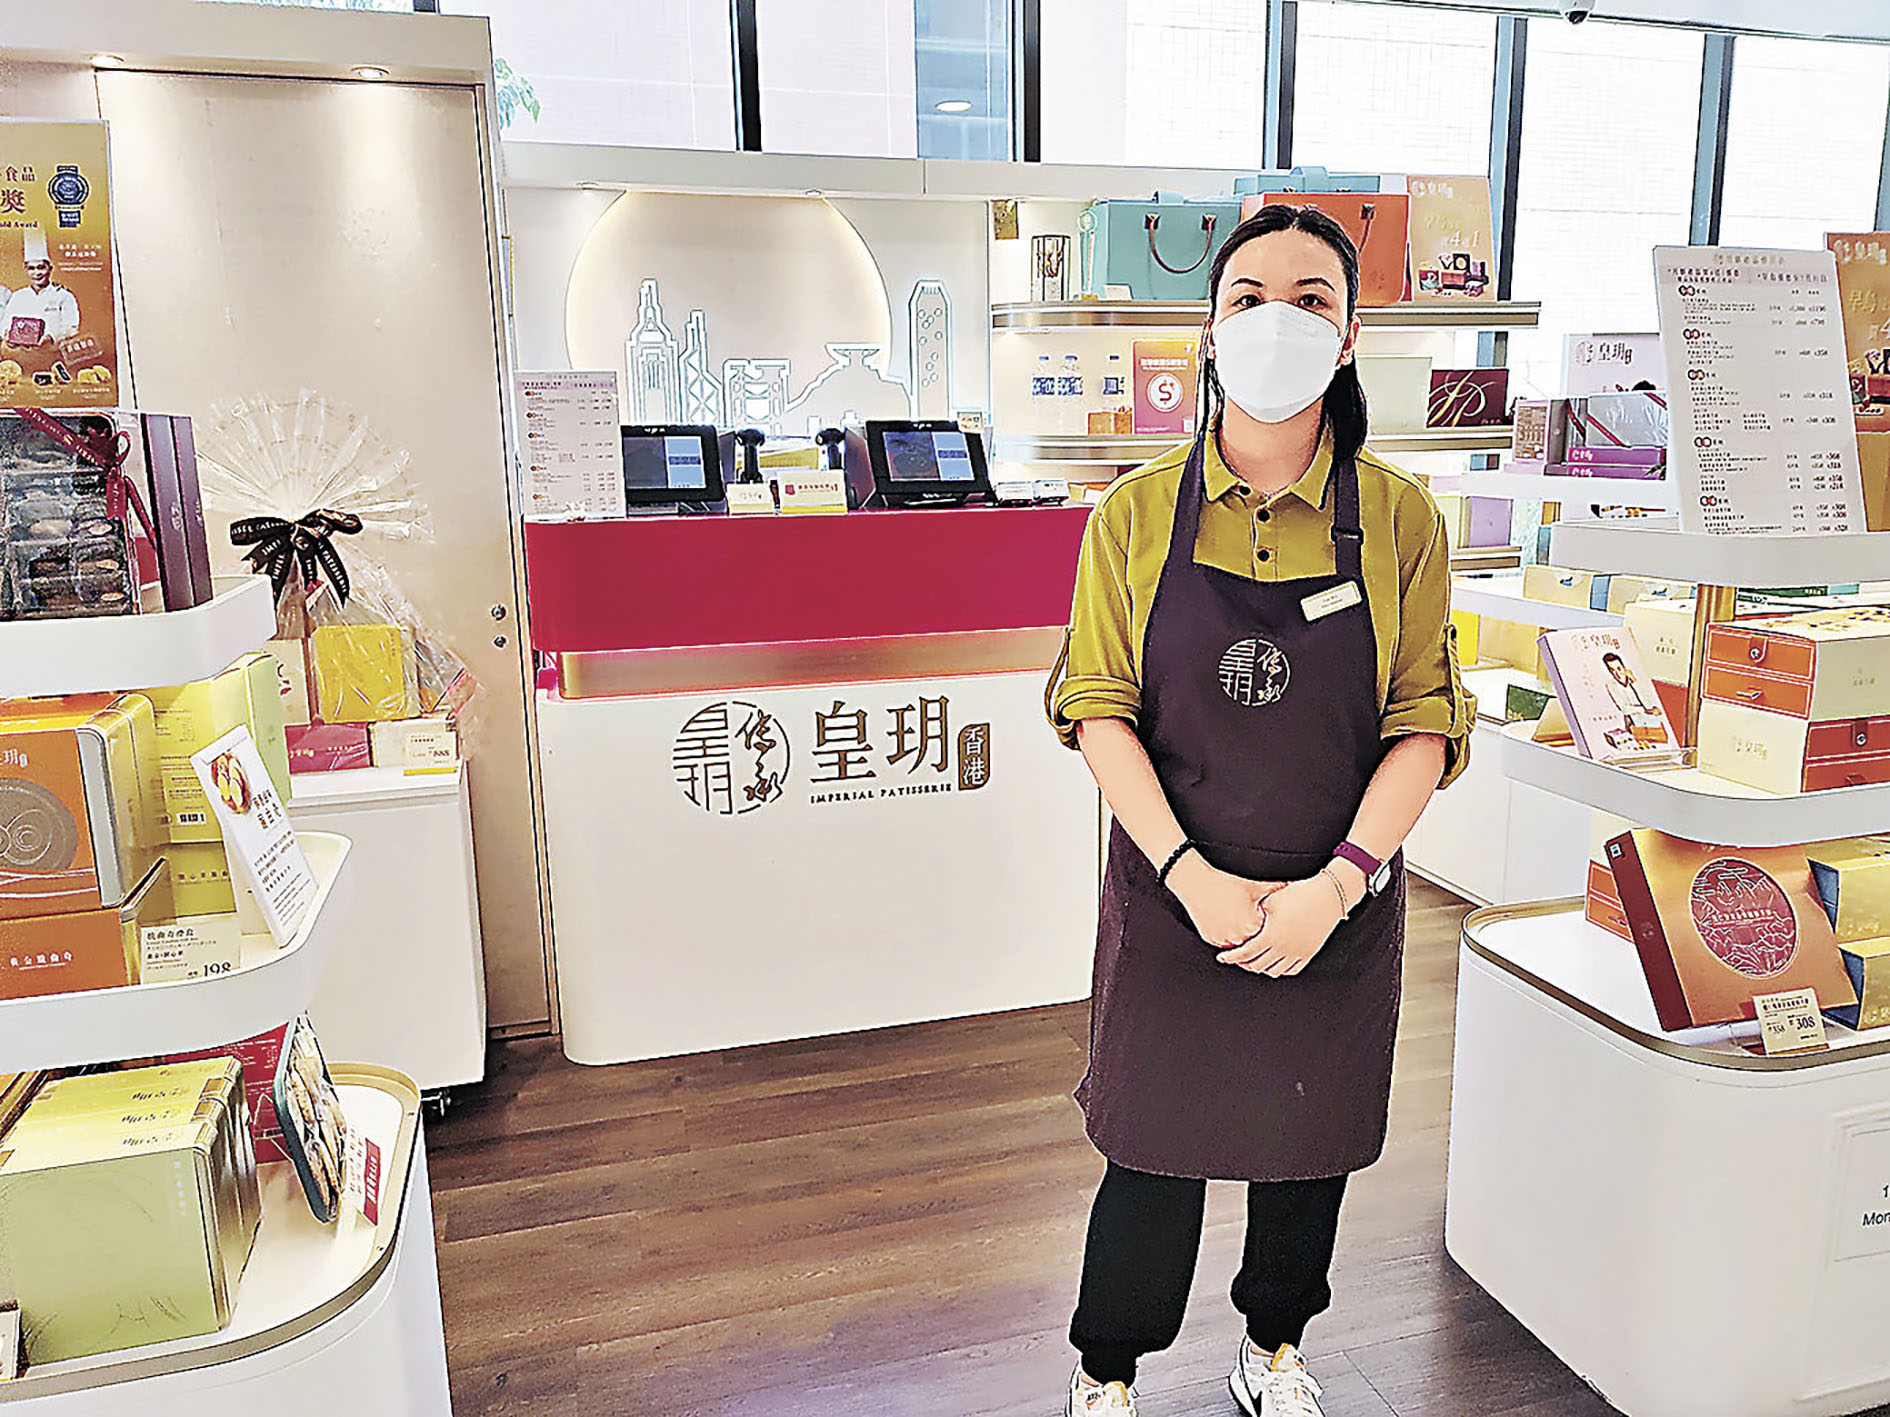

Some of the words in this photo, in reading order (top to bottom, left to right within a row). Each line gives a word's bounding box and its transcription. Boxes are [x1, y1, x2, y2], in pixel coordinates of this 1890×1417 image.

[0, 165, 35, 182] 食品
[809, 696, 950, 784] 皇玥
[962, 726, 986, 787] 香港
[810, 790, 875, 804] IMPERIAL
[880, 782, 952, 800] PATISSERIE
[203, 961, 232, 977] 198
[1796, 1015, 1816, 1031] 308
